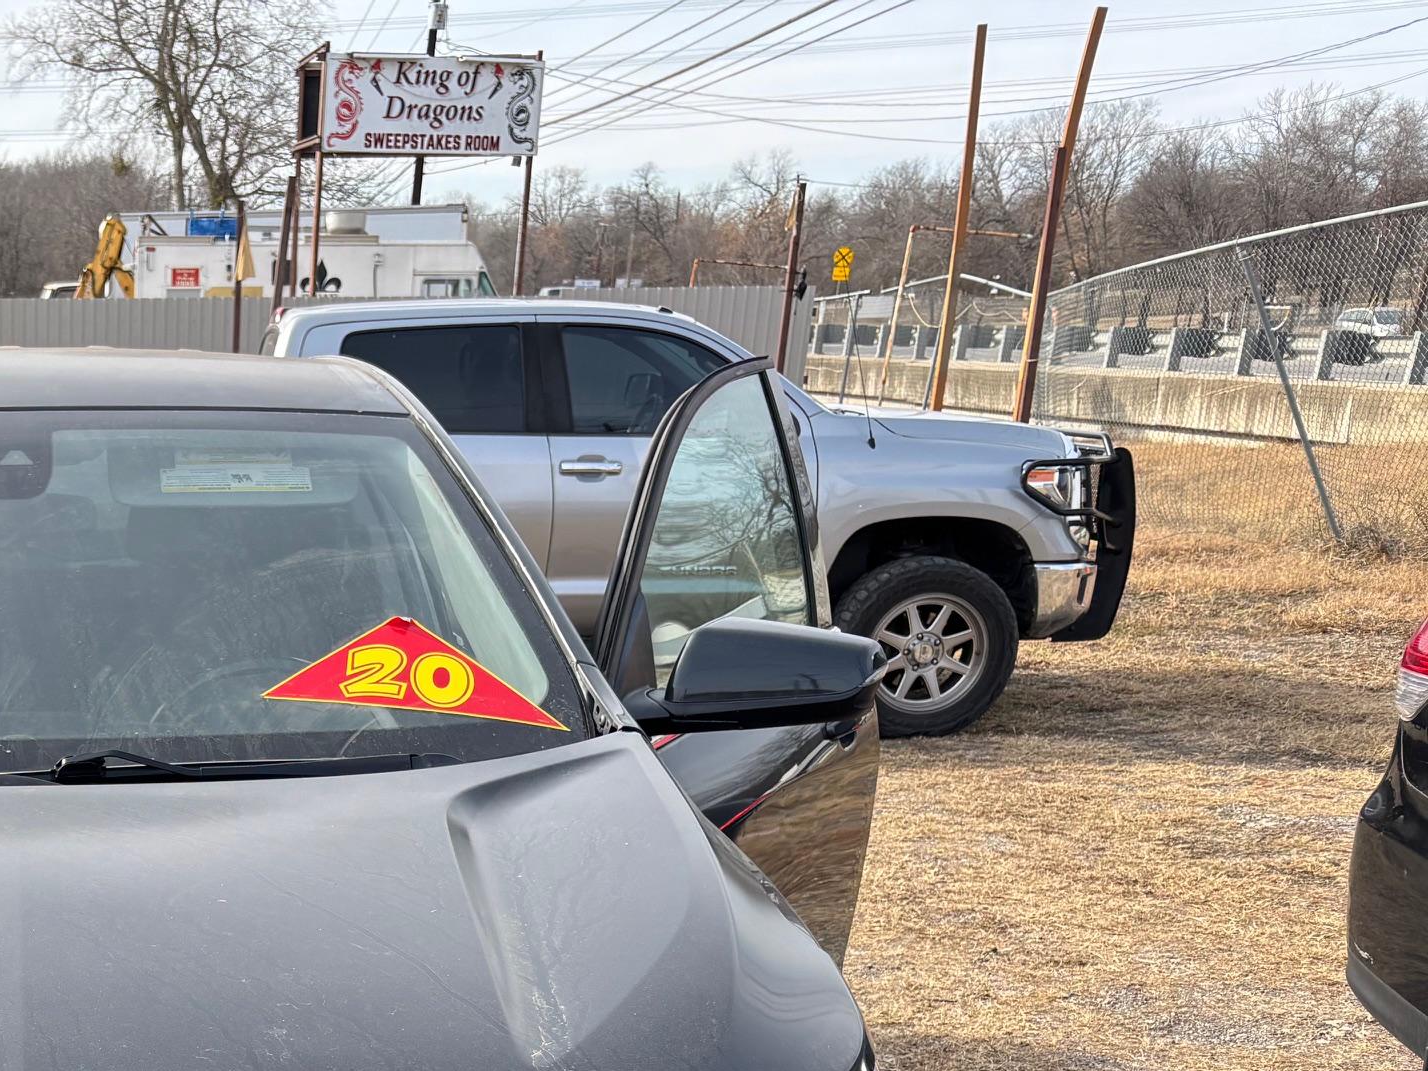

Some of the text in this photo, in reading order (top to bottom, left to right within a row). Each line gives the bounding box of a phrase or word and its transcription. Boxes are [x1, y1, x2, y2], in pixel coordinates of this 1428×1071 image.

[393, 60, 485, 96] King of
[382, 95, 486, 130] Dragons
[364, 132, 501, 152] SWEEPSTAKES ROOM
[339, 644, 475, 708] 20
